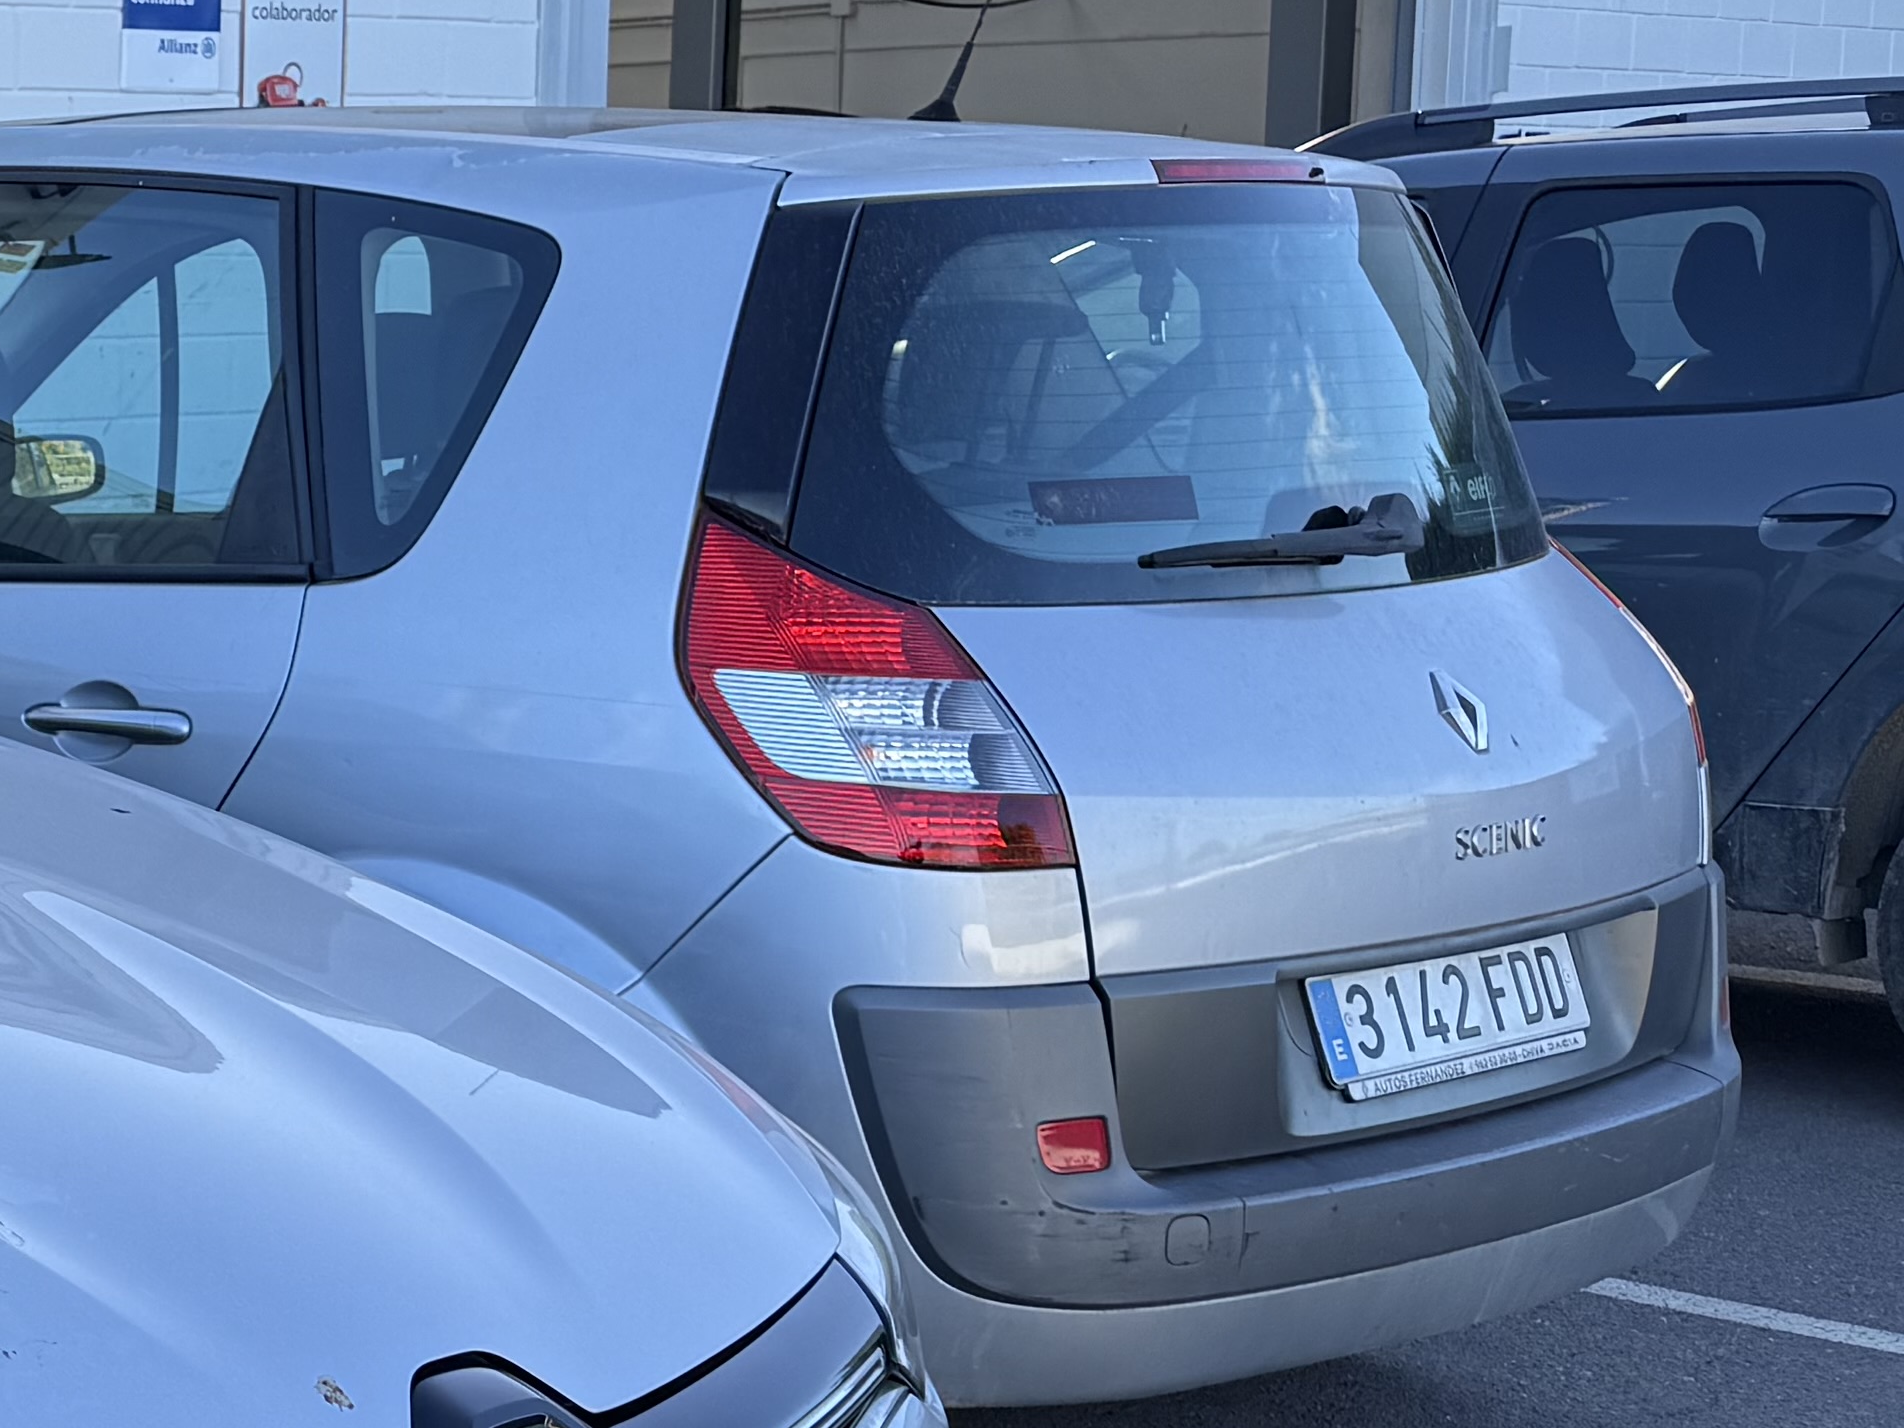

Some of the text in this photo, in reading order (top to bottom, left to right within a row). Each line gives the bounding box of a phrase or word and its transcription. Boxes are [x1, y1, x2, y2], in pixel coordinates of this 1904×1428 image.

[251, 2, 338, 22] colaborador
[158, 38, 199, 55] Allianz
[1455, 814, 1547, 861] SCENIC
[1332, 946, 1570, 1062] E 3142 FDD
